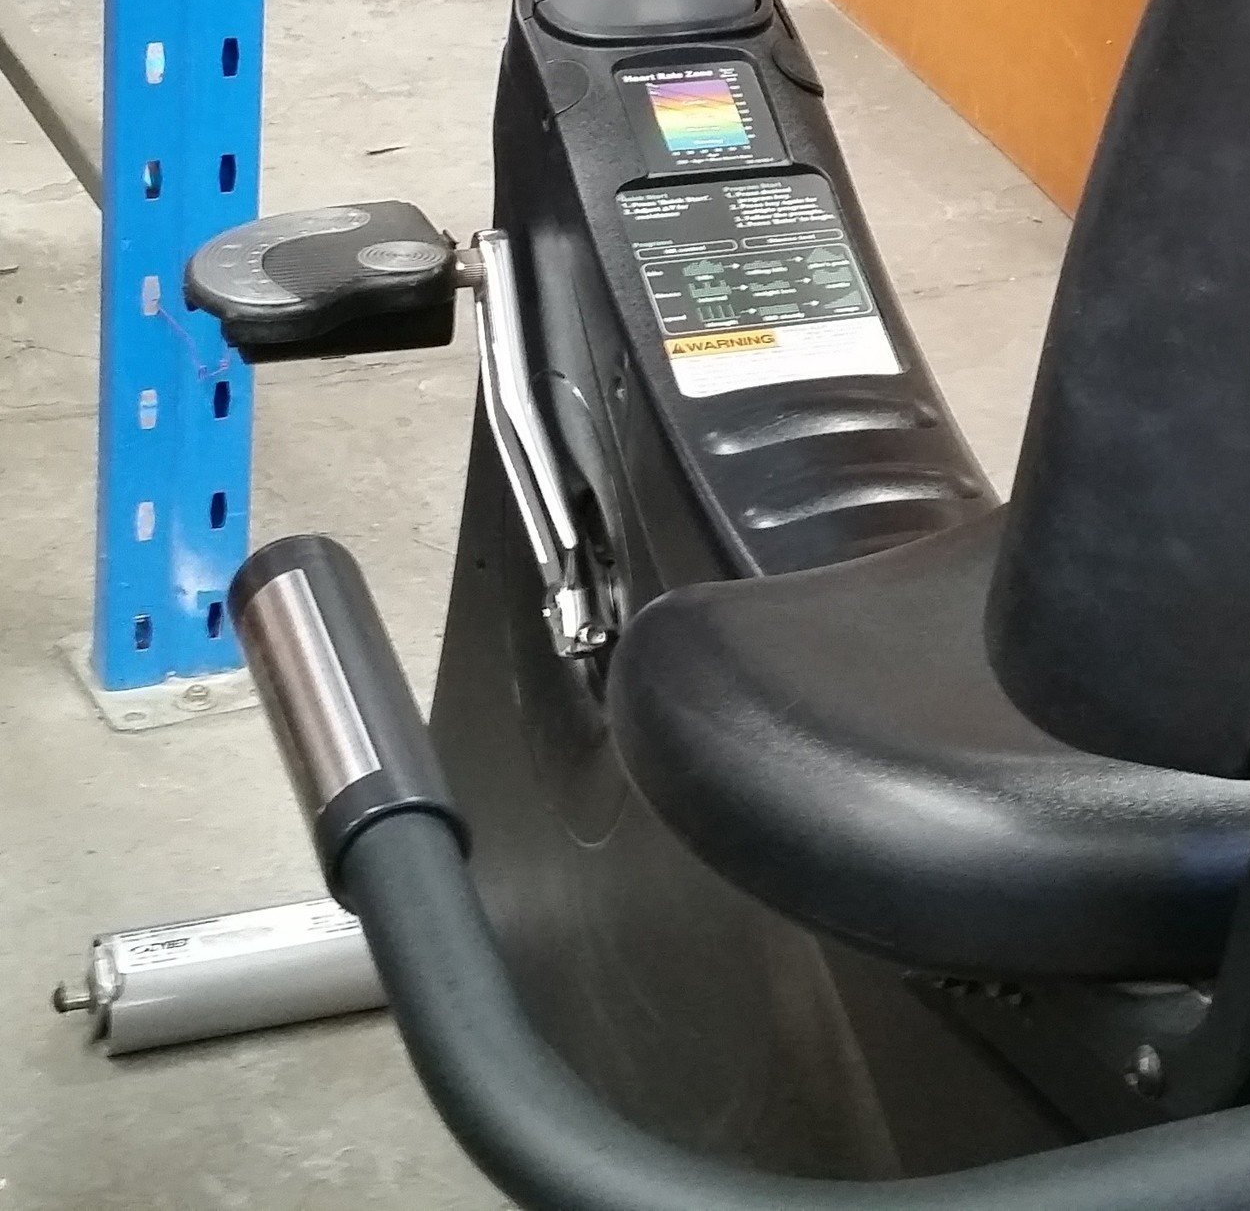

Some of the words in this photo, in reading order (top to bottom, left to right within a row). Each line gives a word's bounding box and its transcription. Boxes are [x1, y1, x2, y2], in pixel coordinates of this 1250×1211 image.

[622, 74, 655, 83] Heart
[656, 72, 684, 81] Rate
[685, 69, 714, 78] Zone
[686, 333, 775, 354] WARNING
